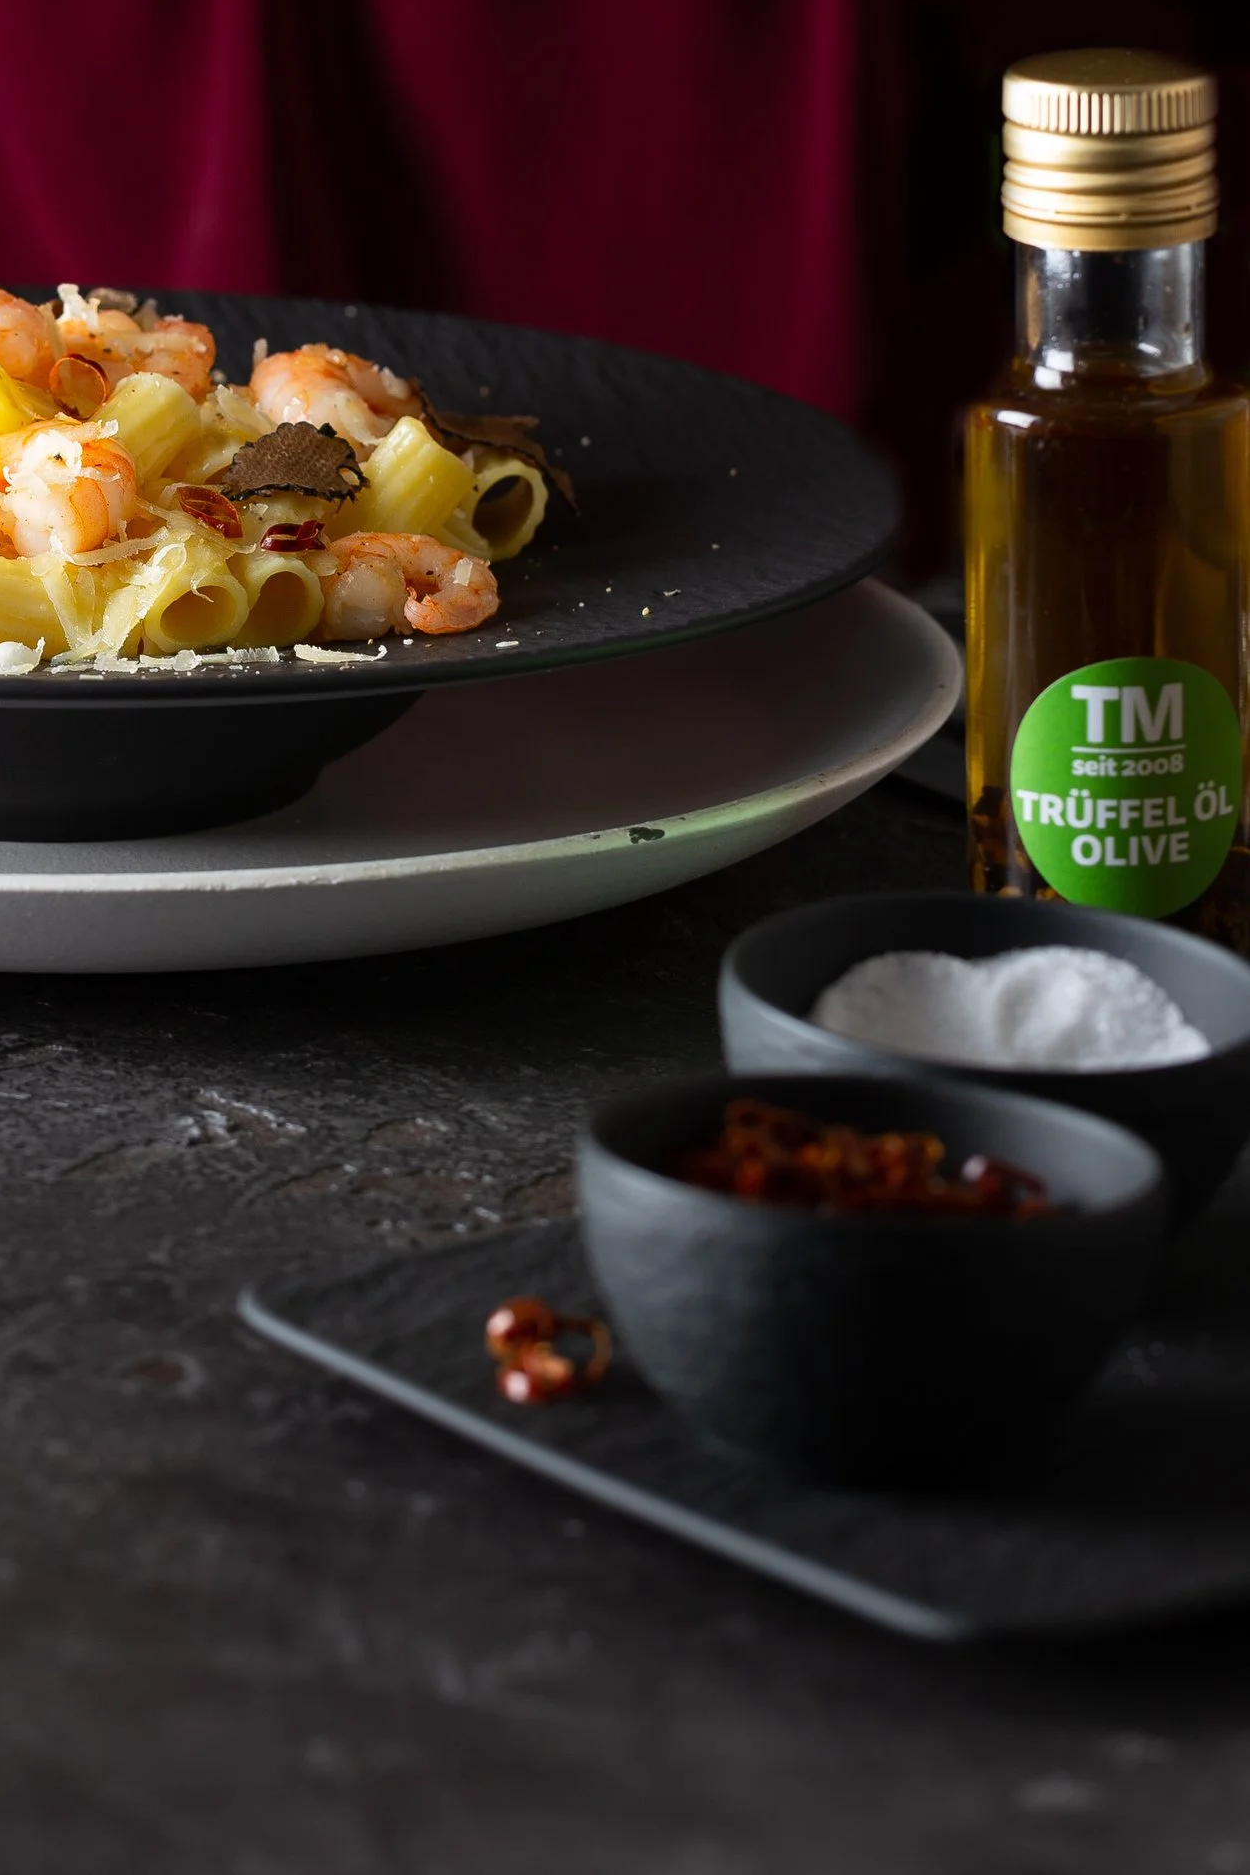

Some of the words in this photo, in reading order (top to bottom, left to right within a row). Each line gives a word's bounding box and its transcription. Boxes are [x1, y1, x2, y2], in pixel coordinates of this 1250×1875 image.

[1070, 682, 1183, 744] TM
[1071, 755, 1117, 777] seit
[1121, 752, 1185, 776] 2008
[1016, 788, 1187, 830] TRÜFFEL
[1193, 780, 1234, 822] ÖL
[1070, 831, 1190, 867] OLIVE
